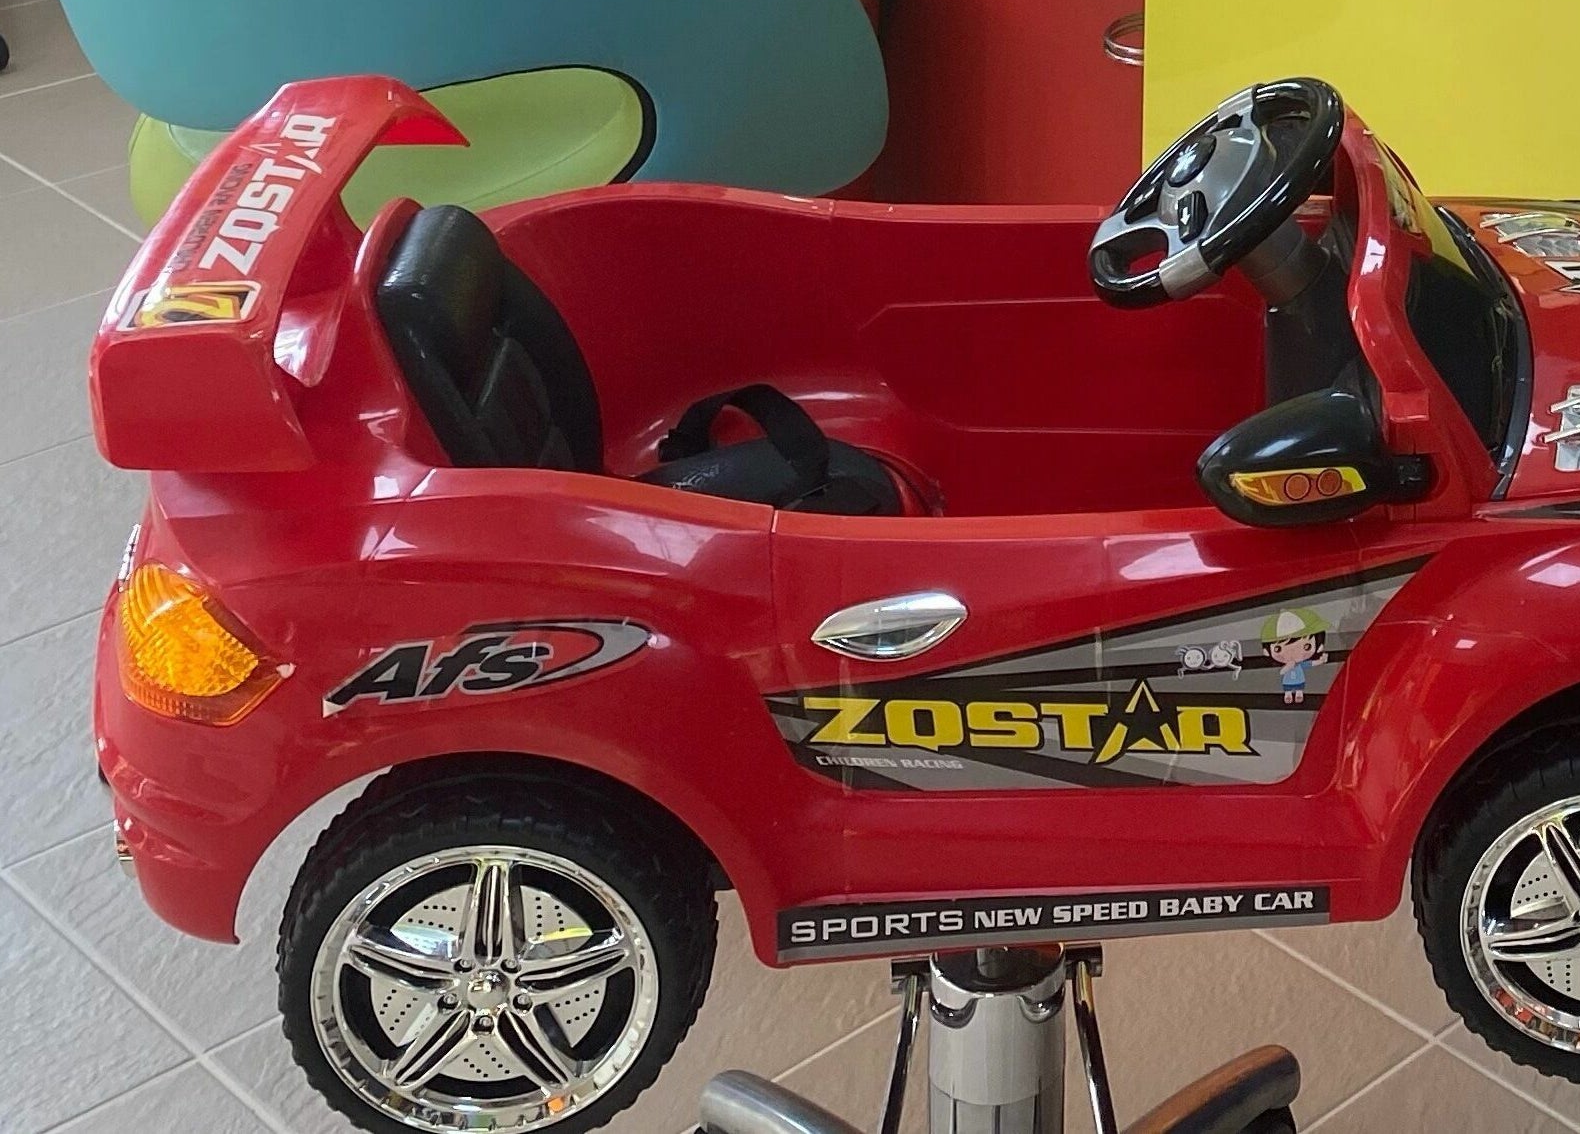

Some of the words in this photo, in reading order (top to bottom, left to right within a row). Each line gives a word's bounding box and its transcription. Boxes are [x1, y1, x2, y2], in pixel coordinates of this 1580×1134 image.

[197, 113, 338, 277] ZQSTAR
[803, 679, 1256, 764] ZQSTAR
[815, 755, 898, 768] CHILDREN
[900, 759, 964, 770] RACING
[791, 910, 964, 944] SPORTS
[973, 907, 1043, 929] NEW
[1052, 901, 1149, 925] SPEED
[1159, 895, 1244, 917] BABY
[1253, 890, 1314, 912] CAR
